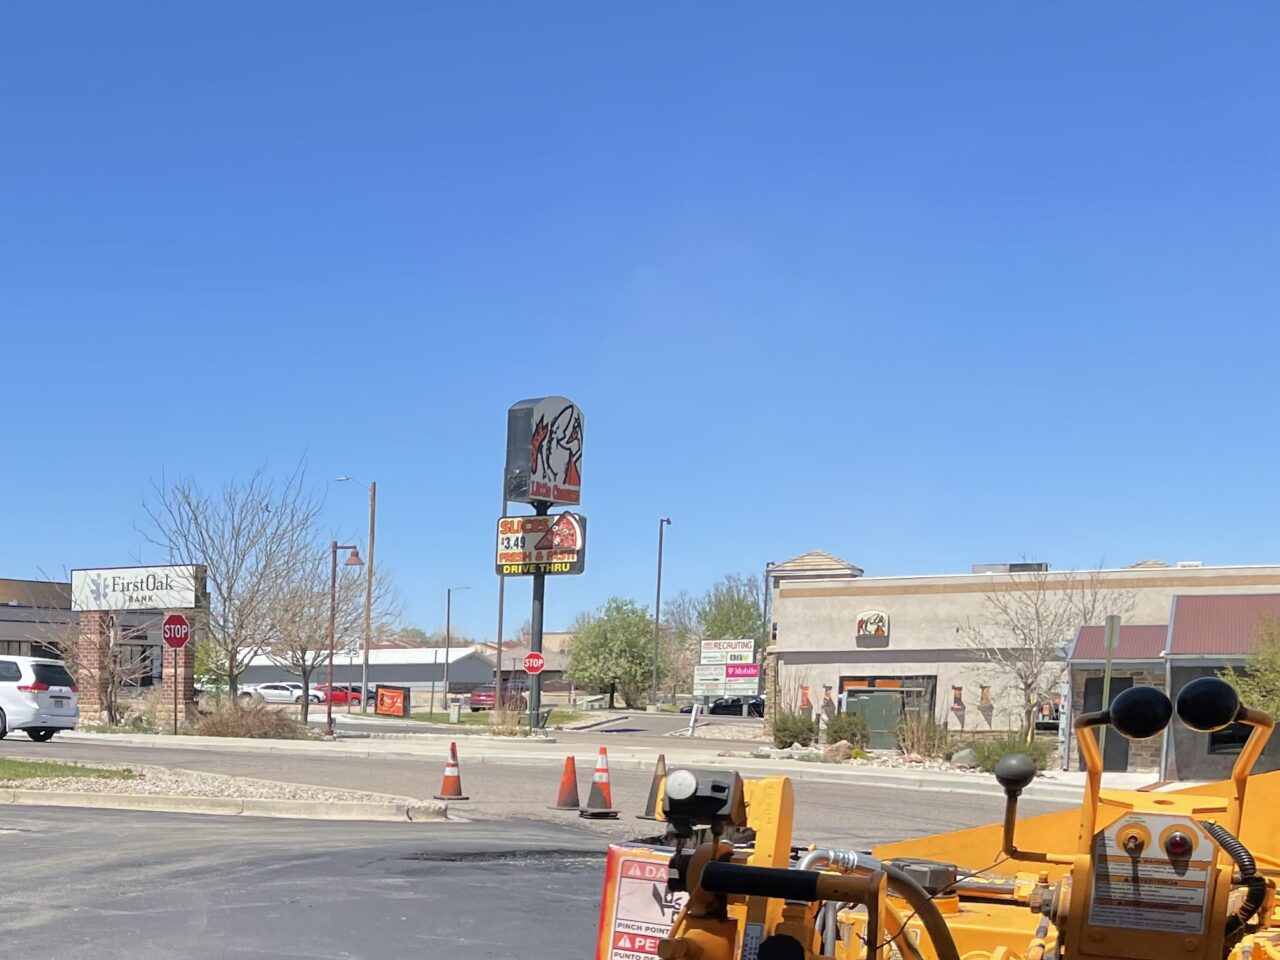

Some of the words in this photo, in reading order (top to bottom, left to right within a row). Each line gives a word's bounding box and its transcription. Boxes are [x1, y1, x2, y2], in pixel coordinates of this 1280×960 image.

[500, 519, 549, 534] SLICES
[503, 563, 536, 574] DRIVE
[539, 562, 570, 572] THRU
[129, 595, 154, 603] BANK
[164, 624, 188, 638] STOP
[713, 641, 752, 650] RECRUITING
[524, 658, 544, 668] STOP
[617, 923, 642, 931] PINCH
[645, 926, 670, 935] POINT
[613, 952, 641, 960] PUNTO
